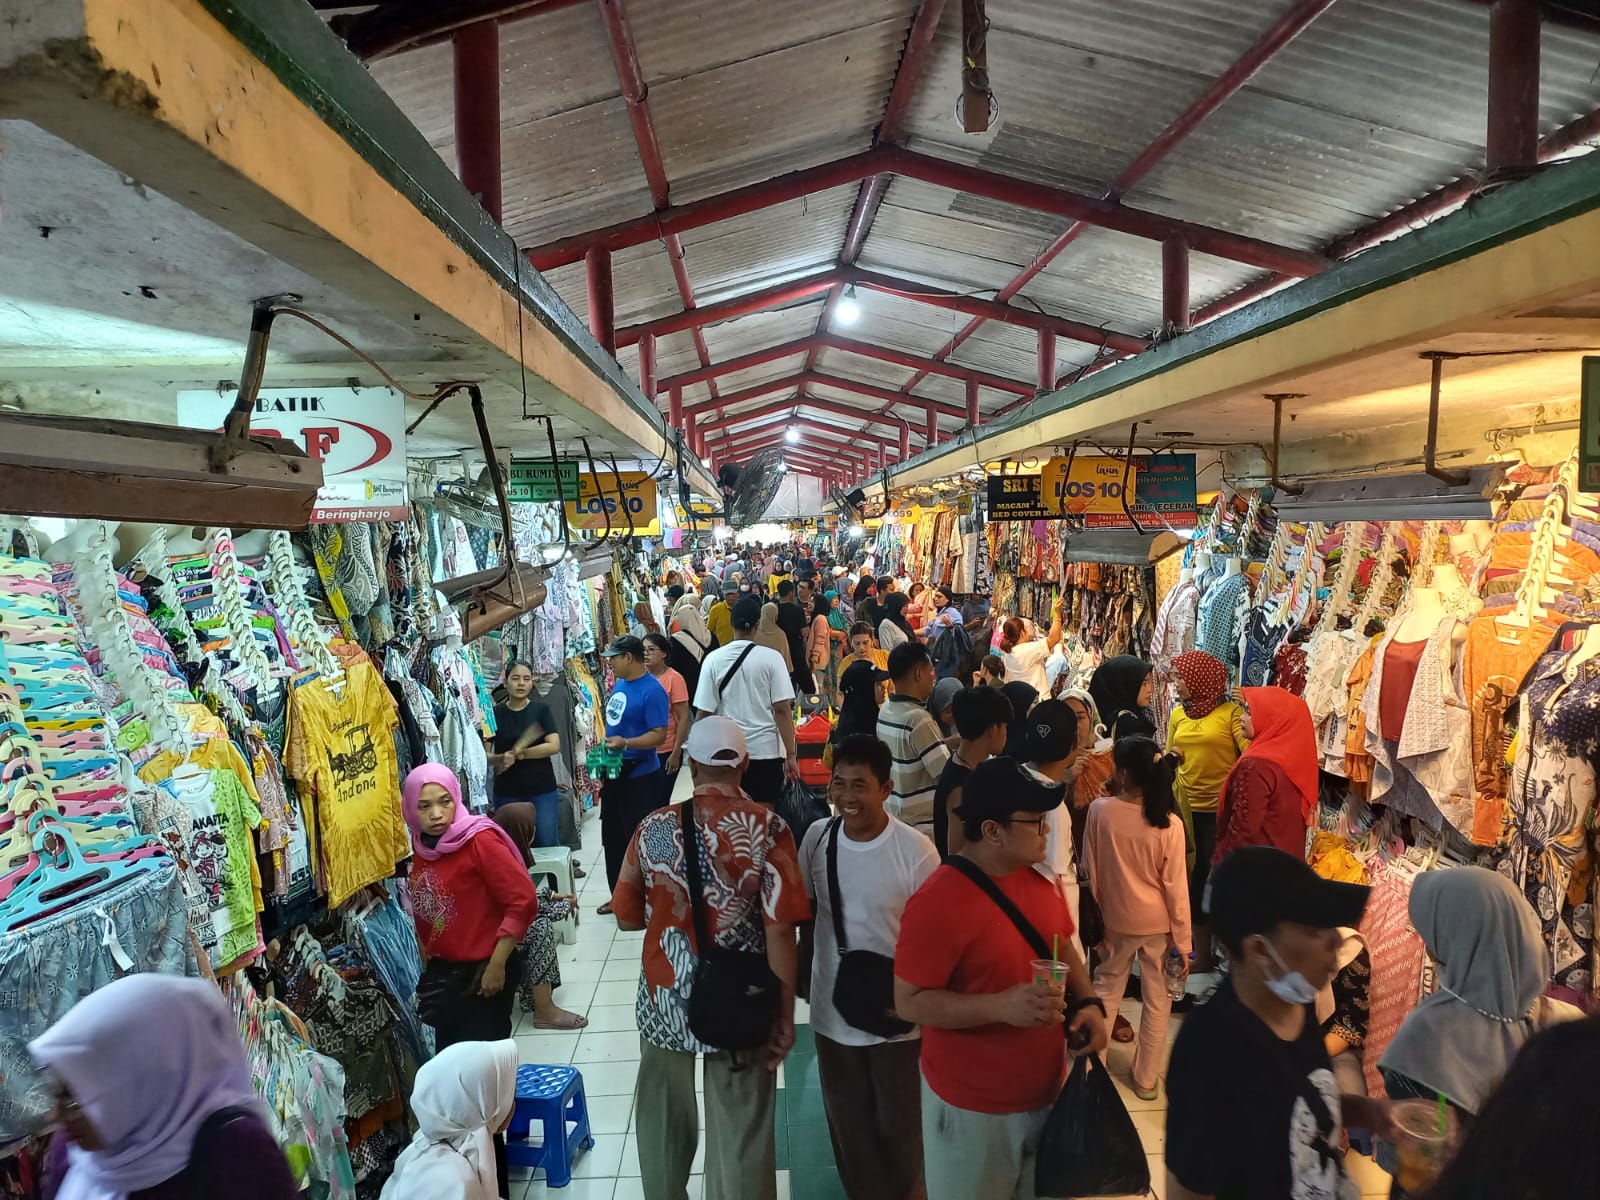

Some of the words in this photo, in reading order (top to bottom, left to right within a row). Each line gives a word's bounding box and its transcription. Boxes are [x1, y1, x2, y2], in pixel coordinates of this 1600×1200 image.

[255, 396, 326, 413] BATIK
[526, 469, 571, 479] RUMIAH
[520, 487, 529, 496] 10
[1002, 478, 1029, 493] SRI
[1055, 481, 1096, 498] LOS
[1098, 482, 1122, 498] 10
[576, 497, 617, 514] LOS
[1157, 502, 1194, 511] ECERAN
[316, 509, 391, 521] Beringharjo
